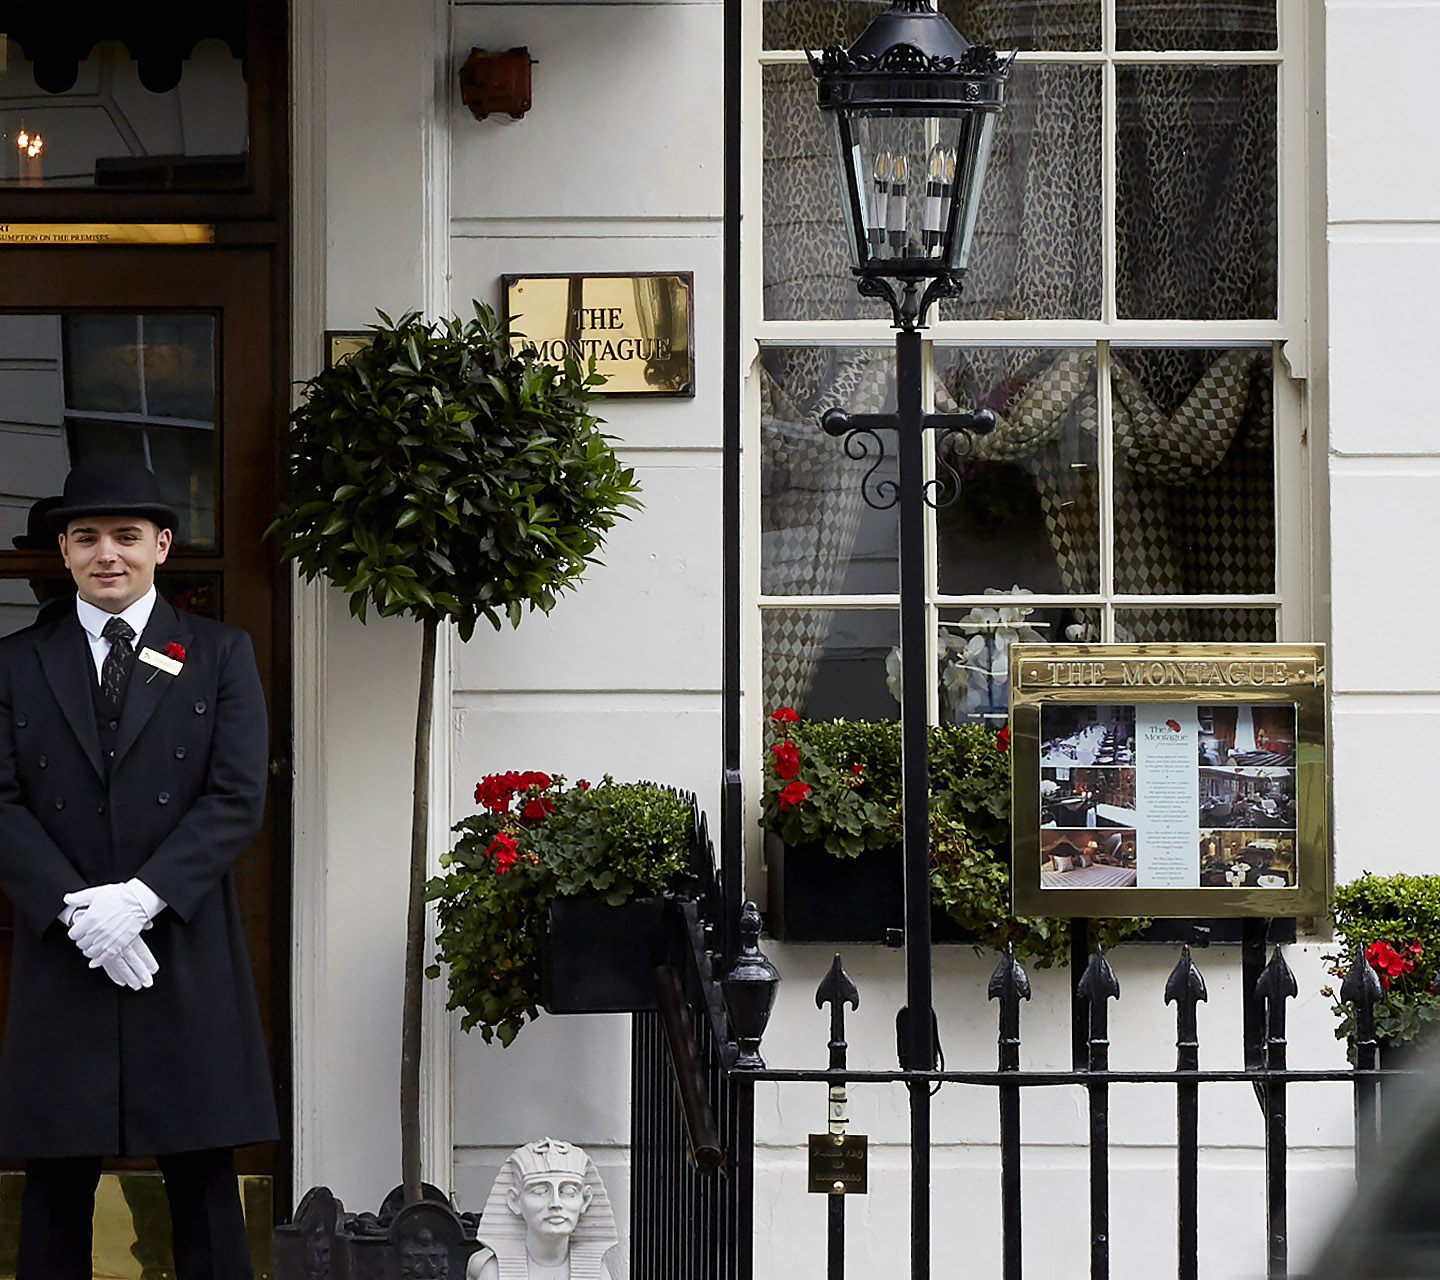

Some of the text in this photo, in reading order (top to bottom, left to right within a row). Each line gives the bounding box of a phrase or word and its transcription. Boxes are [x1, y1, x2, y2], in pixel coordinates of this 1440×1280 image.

[573, 307, 624, 331] THE
[529, 336, 672, 361] MONTAGUE
[1047, 662, 1290, 687] THE MONTAGUE
[1144, 733, 1189, 742] Montague
[1150, 725, 1166, 734] The
